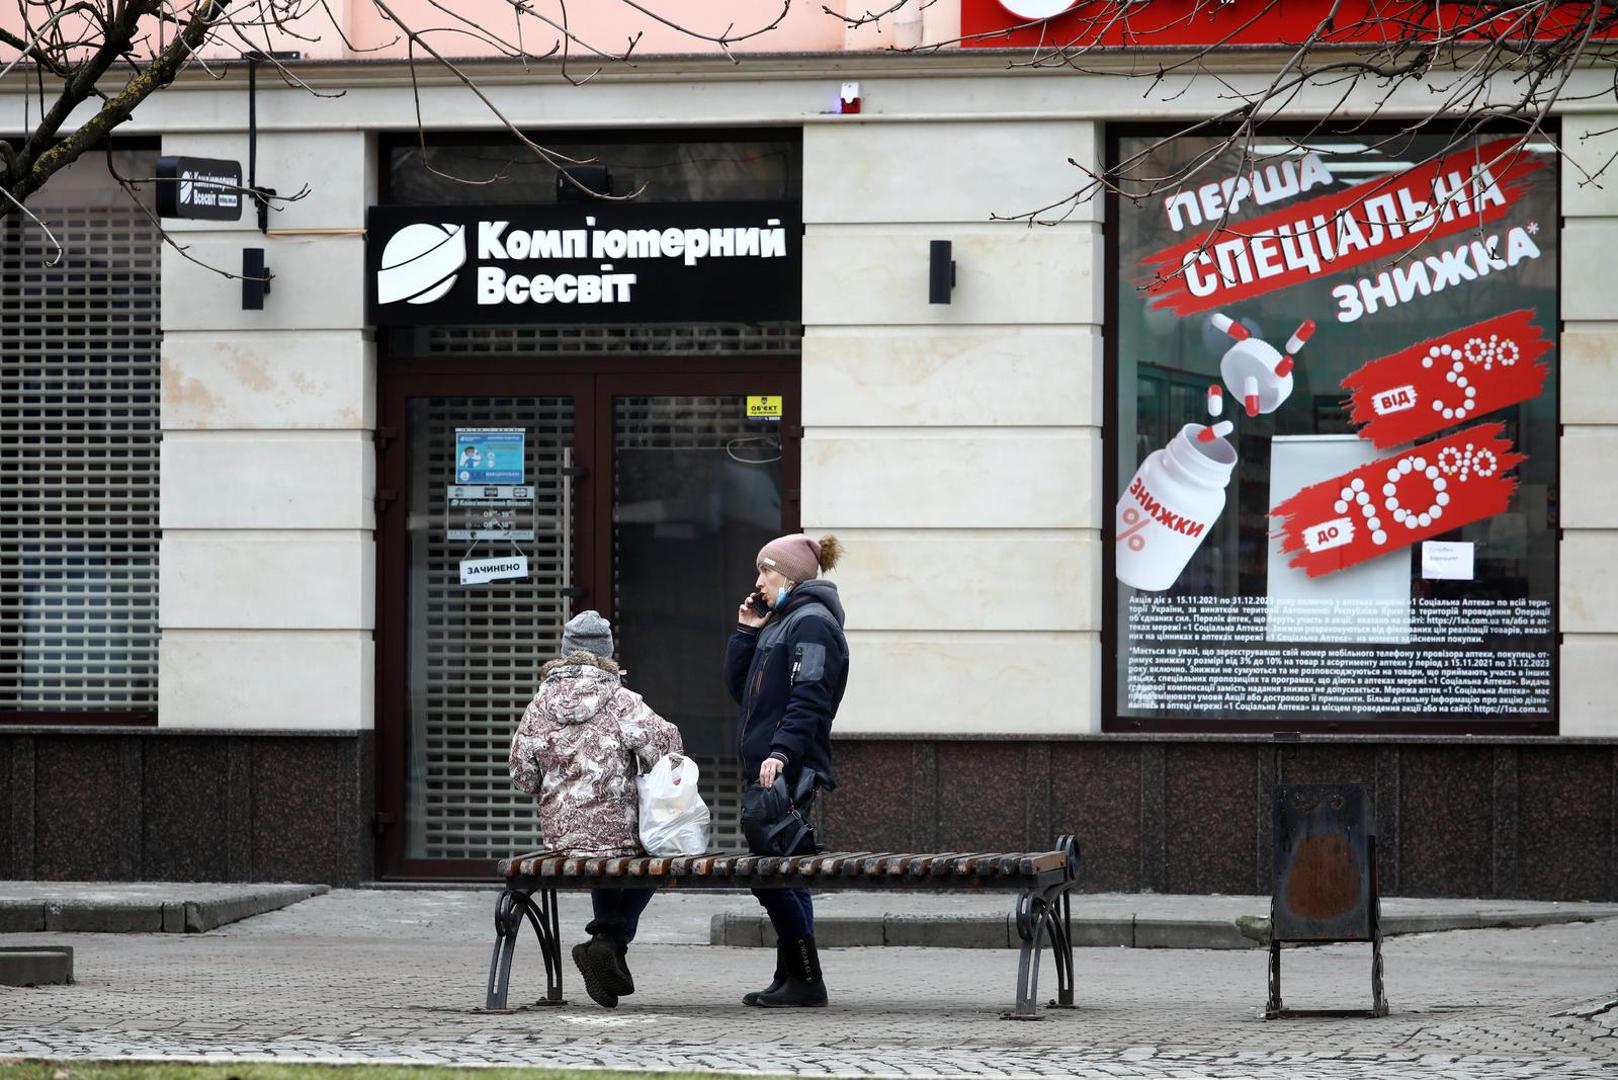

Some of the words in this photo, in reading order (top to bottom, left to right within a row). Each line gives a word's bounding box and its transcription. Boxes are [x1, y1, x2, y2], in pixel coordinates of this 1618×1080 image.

[1165, 153, 1334, 232] ПЕРША
[1182, 163, 1507, 297] СПЕЦІАЛЬНА
[477, 216, 787, 267] Комп'ютерний
[477, 264, 638, 305] Всесвіт
[1421, 334, 1520, 420] 3%
[1381, 391, 1411, 410] ВІД
[1333, 443, 1498, 546] 10%
[1129, 476, 1206, 539] ЗНИЖКИ
[1317, 526, 1340, 545] ДО
[467, 563, 520, 575] ЗАЧИНЕНО
[1129, 596, 1152, 605] Акція
[1177, 596, 1217, 604] 15.11.2021
[1419, 598, 1460, 607] Соціальна
[1510, 598, 1526, 606] всій
[1529, 600, 1550, 608] тери-
[1152, 605, 1184, 614] України,
[1420, 607, 1458, 616] територій
[1515, 607, 1550, 617] Операції
[1194, 614, 1225, 624] Перелік
[1254, 616, 1265, 624] що
[1427, 616, 1499, 625] https://1sa.com.ua
[1502, 616, 1528, 626] та/або
[1152, 623, 1181, 633] мережі
[1194, 624, 1234, 633] Соціальна
[1449, 625, 1488, 635] реалізації
[1157, 632, 1192, 642] цінниках
[1235, 633, 1263, 642] мережі
[1448, 636, 1484, 644] покупки.
[1283, 648, 1298, 656] свій
[1329, 648, 1374, 656] мобільного
[1377, 649, 1413, 658] телефону
[1423, 649, 1463, 658] провізора
[1466, 651, 1495, 659] аптеки,
[1497, 651, 1535, 659] покупець
[1194, 656, 1223, 665] розмірі
[1226, 656, 1238, 666] від
[1240, 656, 1251, 664] 3%
[1254, 658, 1263, 666] до
[1267, 657, 1282, 665] 10%
[1327, 659, 1377, 667] асортименту
[1416, 658, 1442, 668] період
[1452, 659, 1492, 667] 15.11.2021
[1190, 665, 1220, 673] Знижки
[1235, 667, 1276, 675] сумуються
[1301, 668, 1380, 676] розповсюджуються
[1427, 669, 1439, 677] що
[1442, 668, 1488, 677] приймають
[1526, 668, 1550, 676] інших
[1159, 674, 1207, 683] спеціальних
[1209, 675, 1259, 684] пропозиціях
[1272, 677, 1316, 685] програмах,
[1319, 677, 1330, 685] що
[1333, 676, 1355, 685] діють
[1398, 676, 1426, 686] мережі
[1440, 677, 1481, 686] Соціальна
[1521, 678, 1550, 687] Видача
[1168, 683, 1215, 693] компенсації
[1217, 684, 1246, 692] замість
[1384, 685, 1416, 695] Мережа
[1455, 686, 1495, 696] Соціальна
[1198, 694, 1222, 702] умови
[1225, 693, 1245, 702] Акції
[1247, 693, 1260, 701] або
[1263, 695, 1309, 703] достроково
[1319, 695, 1365, 703] припинити.
[1367, 694, 1391, 702] Більш
[1393, 696, 1429, 704] детальну
[1431, 695, 1480, 704] інформацію
[1500, 695, 1523, 705] акцію
[1167, 701, 1191, 710] аптеці
[1194, 701, 1222, 711] мережі
[1235, 702, 1275, 711] Соціальна
[1322, 703, 1350, 712] місцем
[1402, 703, 1421, 713] акції
[1423, 704, 1437, 712] або
